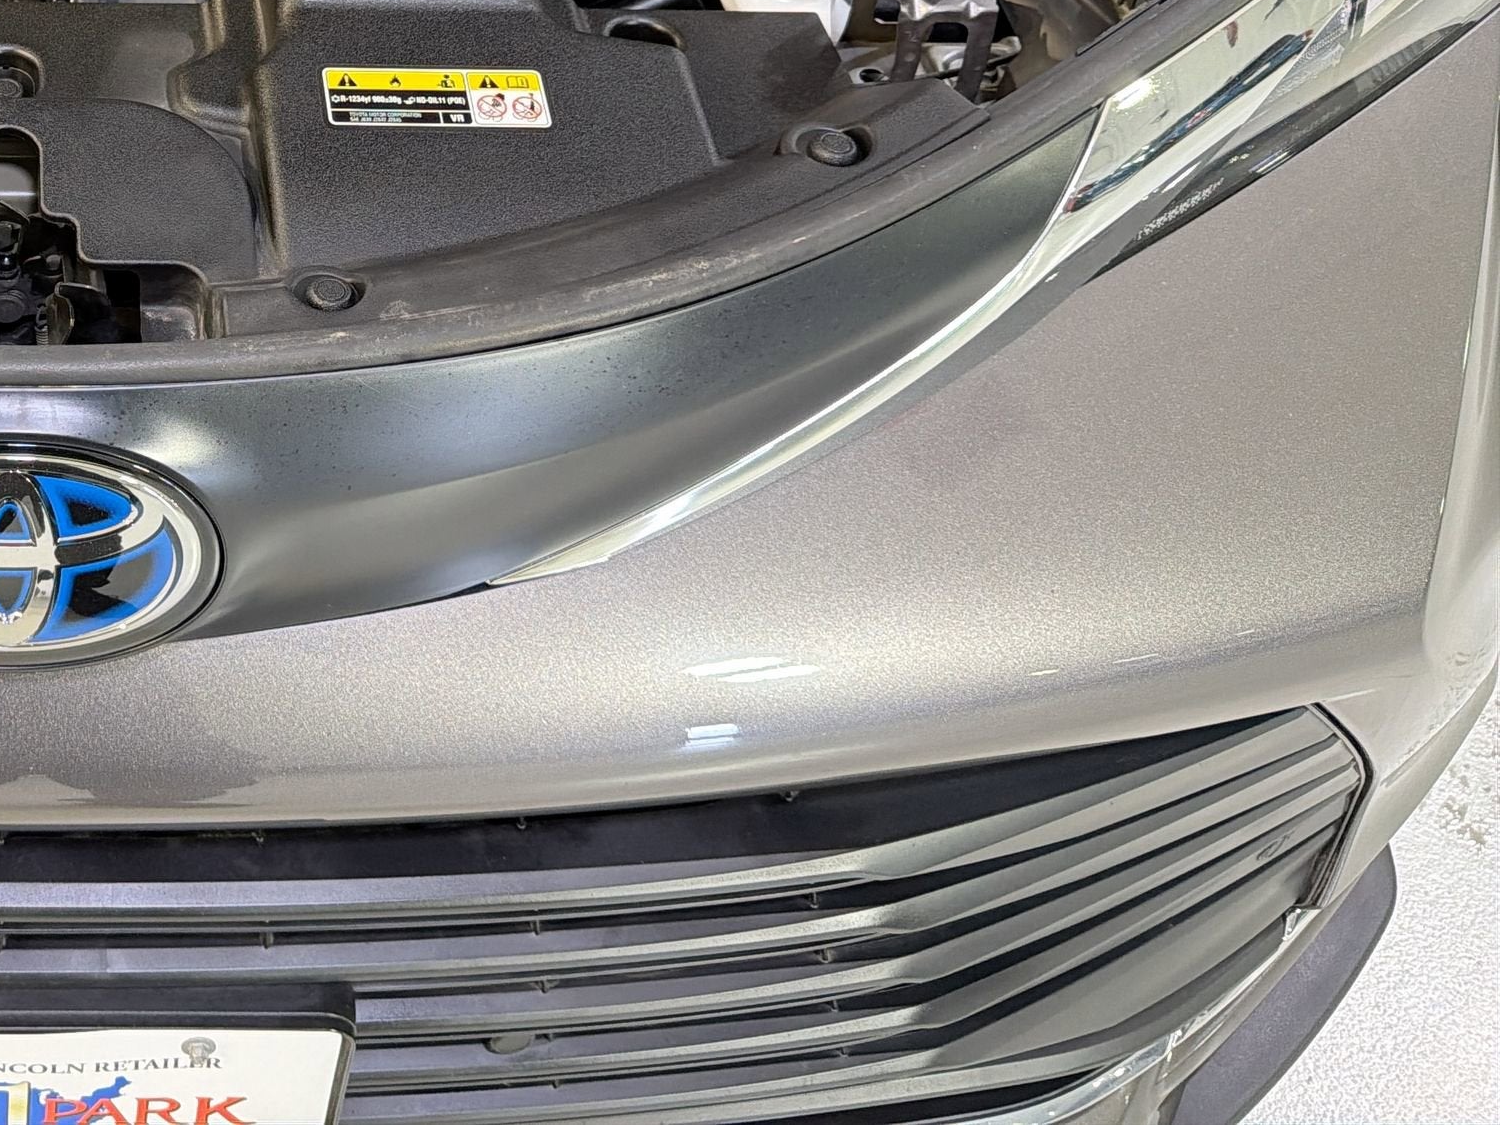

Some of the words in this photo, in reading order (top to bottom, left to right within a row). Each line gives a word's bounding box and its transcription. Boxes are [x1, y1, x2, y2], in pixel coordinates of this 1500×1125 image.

[340, 95, 371, 104] R-1234yf
[447, 96, 466, 106] (POE)
[450, 114, 465, 122] VR
[42, 1096, 257, 1125] PARK
